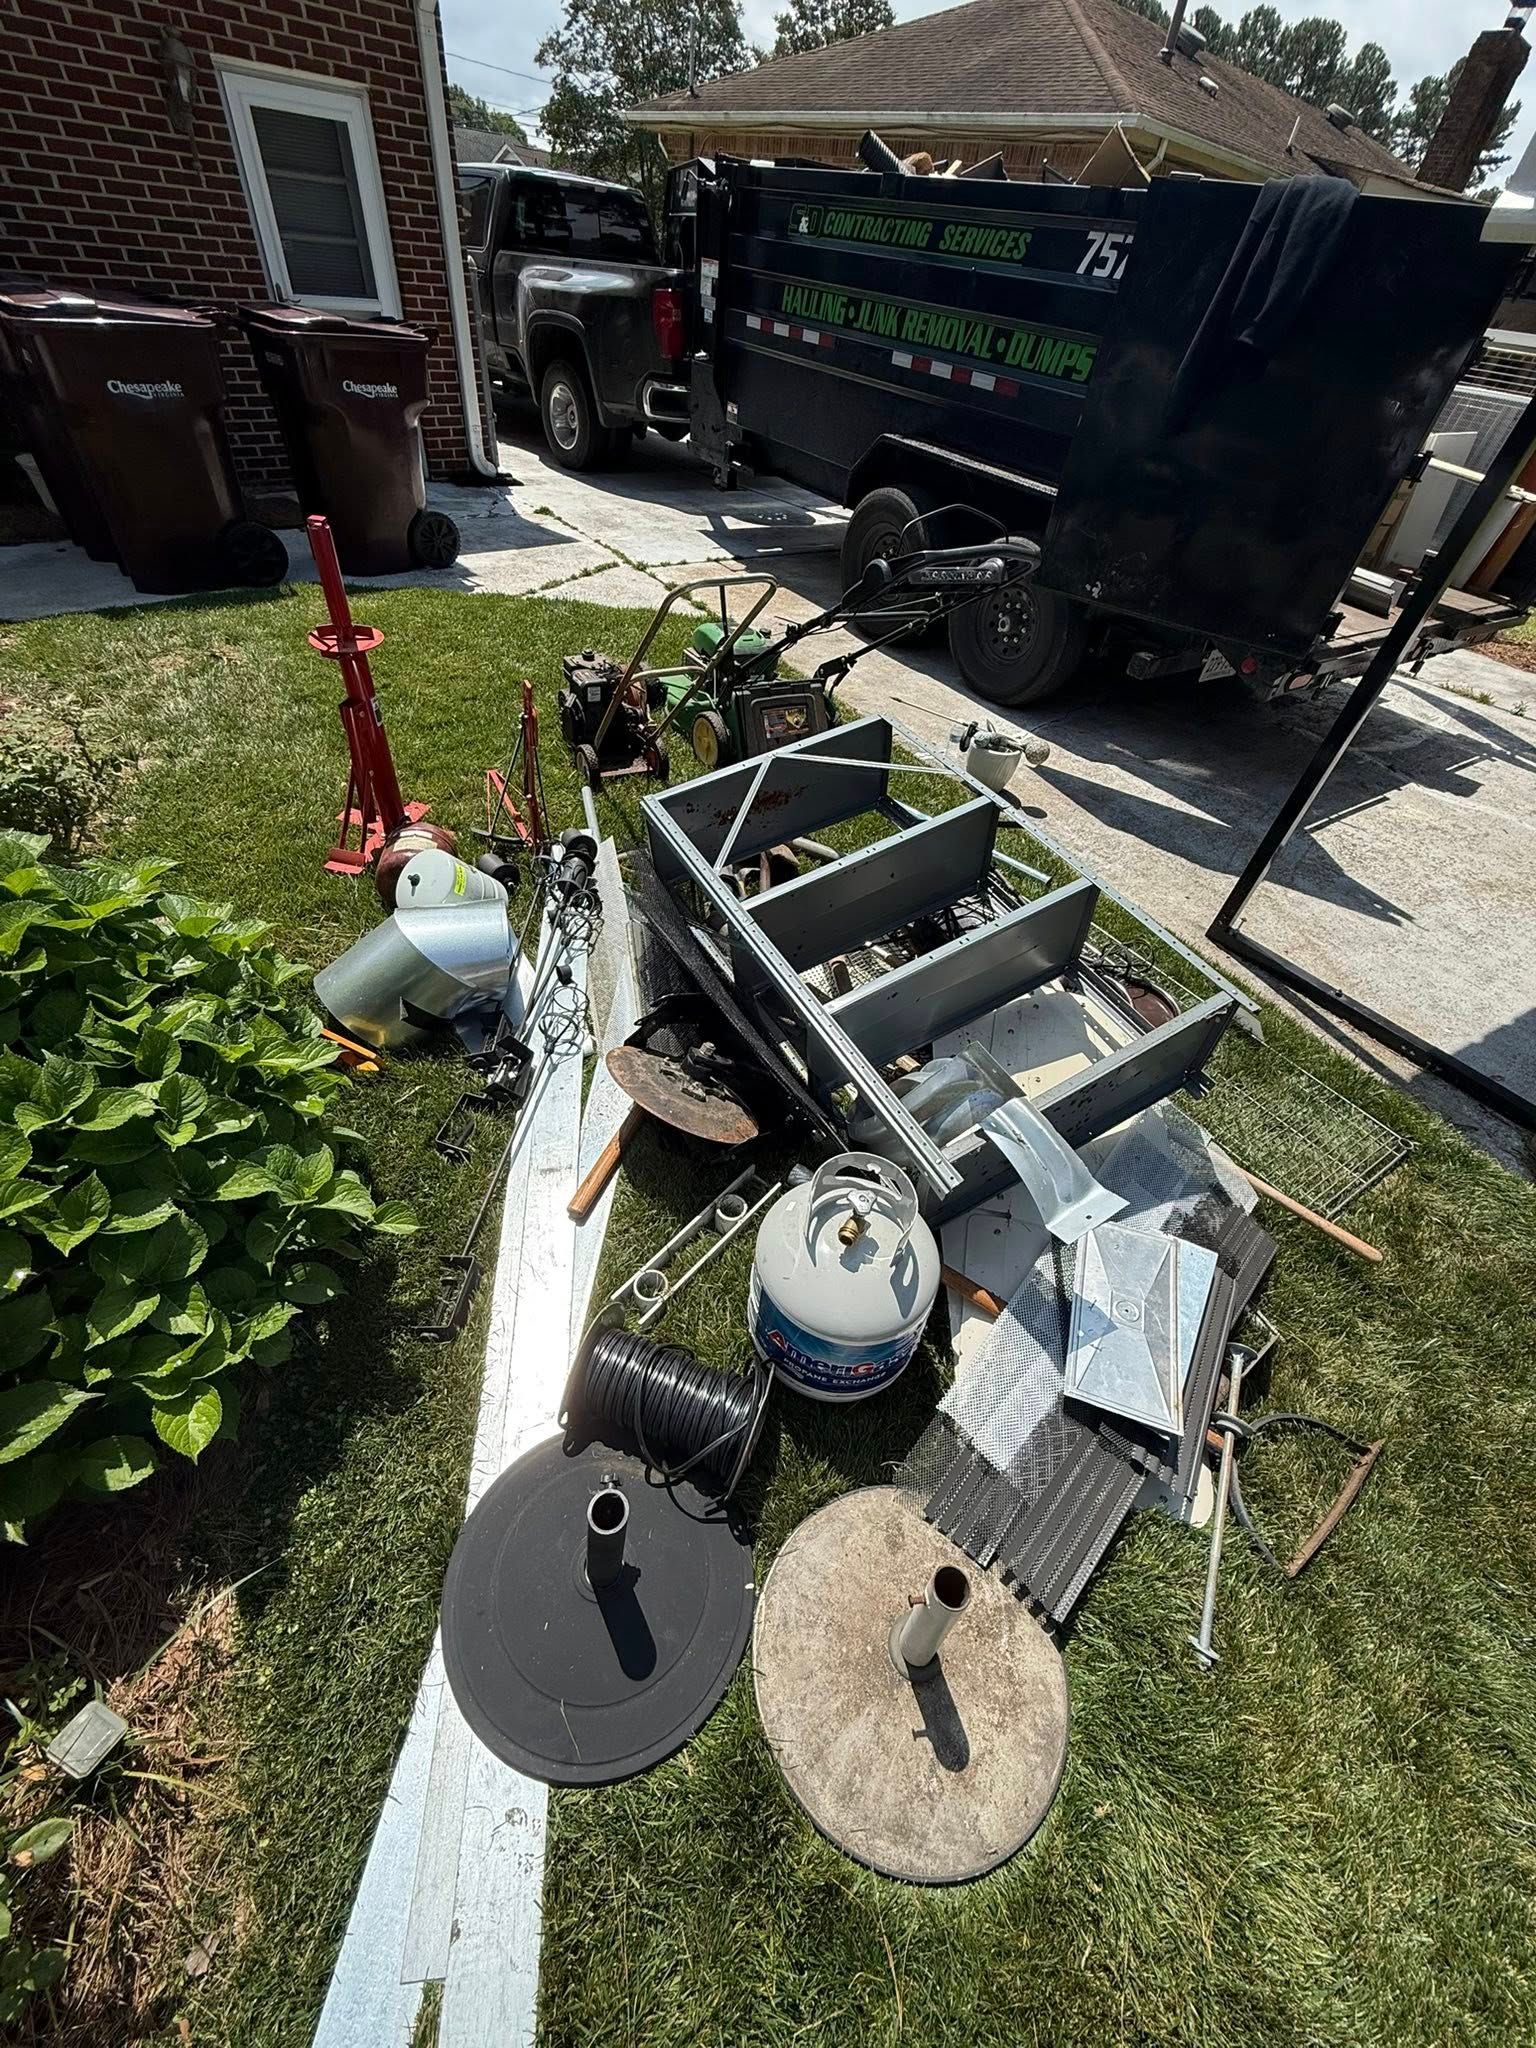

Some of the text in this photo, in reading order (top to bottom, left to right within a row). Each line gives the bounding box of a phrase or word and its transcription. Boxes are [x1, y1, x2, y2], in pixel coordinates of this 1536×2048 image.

[823, 210, 933, 248] CONTRACTING
[939, 224, 1032, 261] SERVICES
[781, 285, 1098, 382] HAULING JUNK REMOVAL DUMPS
[106, 379, 183, 399] Chesapeake
[342, 379, 398, 398] Chesapeake
[783, 1357, 887, 1385] PROPANE EXCHANGE
